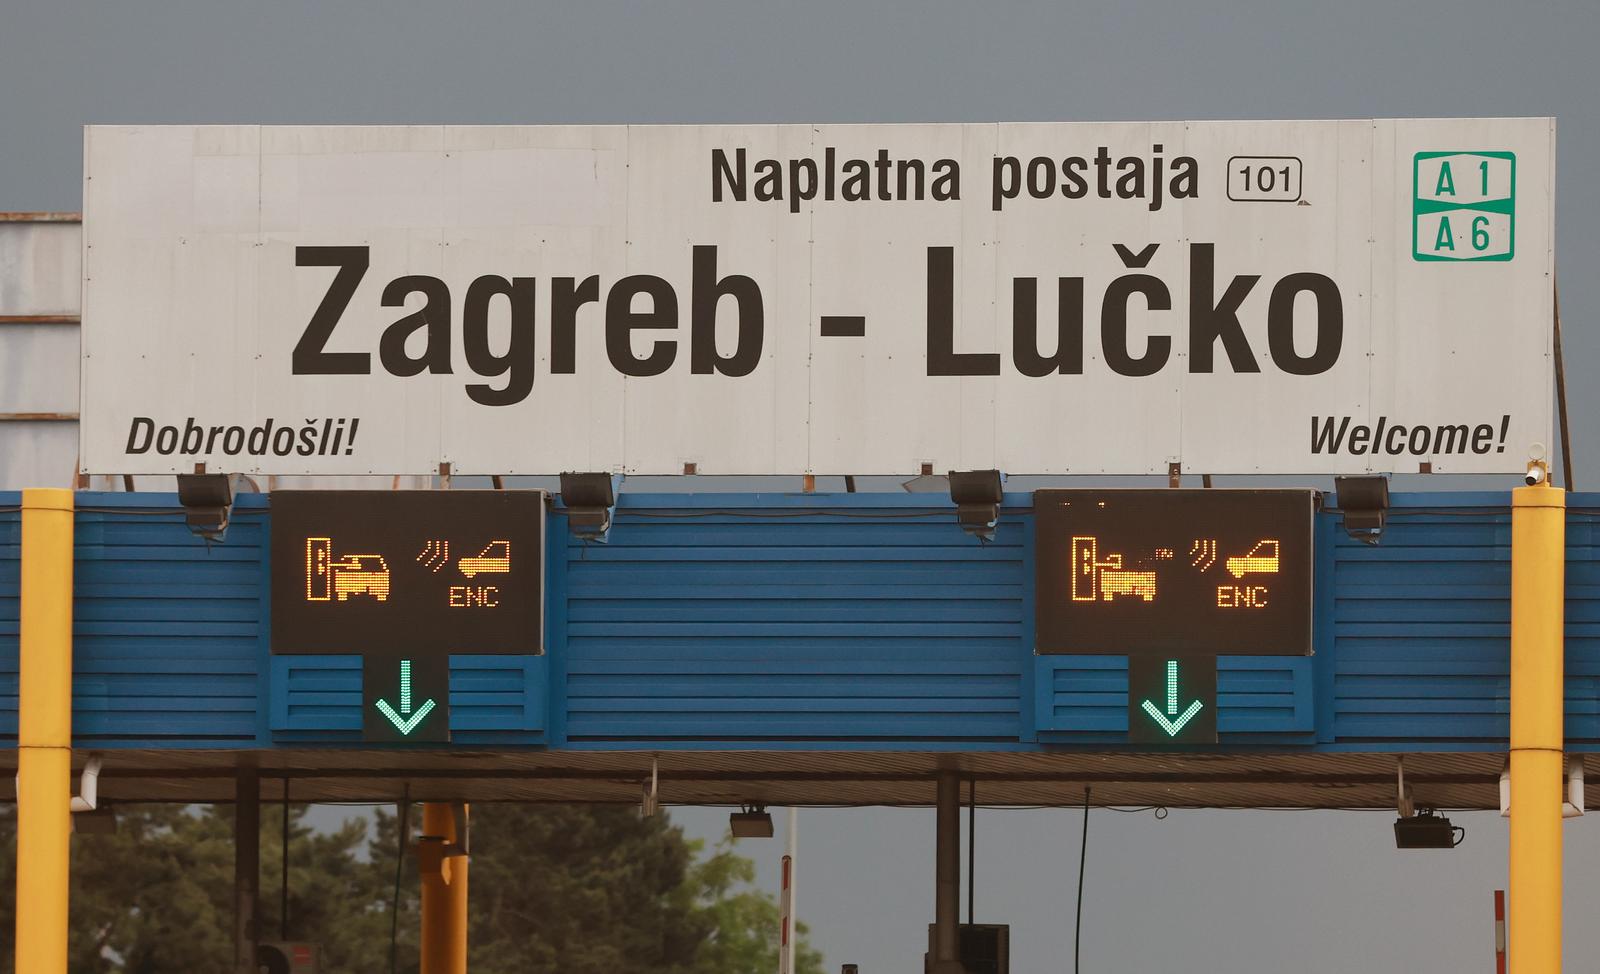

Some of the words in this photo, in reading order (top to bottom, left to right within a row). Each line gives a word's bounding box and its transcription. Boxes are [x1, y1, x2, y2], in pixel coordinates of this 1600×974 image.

[712, 148, 960, 213] Naplatna
[992, 144, 1198, 211] postaja
[1239, 165, 1290, 193] 101
[1435, 161, 1456, 196] A
[1479, 161, 1489, 196] 1
[1434, 216, 1455, 251] A
[1471, 216, 1490, 251] 6
[292, 245, 764, 406] Zagreb
[821, 316, 866, 337] -
[927, 243, 1343, 377] Lučko
[126, 417, 360, 456] Dobrodošli!
[1311, 415, 1510, 455] Welcome!
[449, 586, 499, 608] ENC
[1217, 586, 1268, 608] ENC
